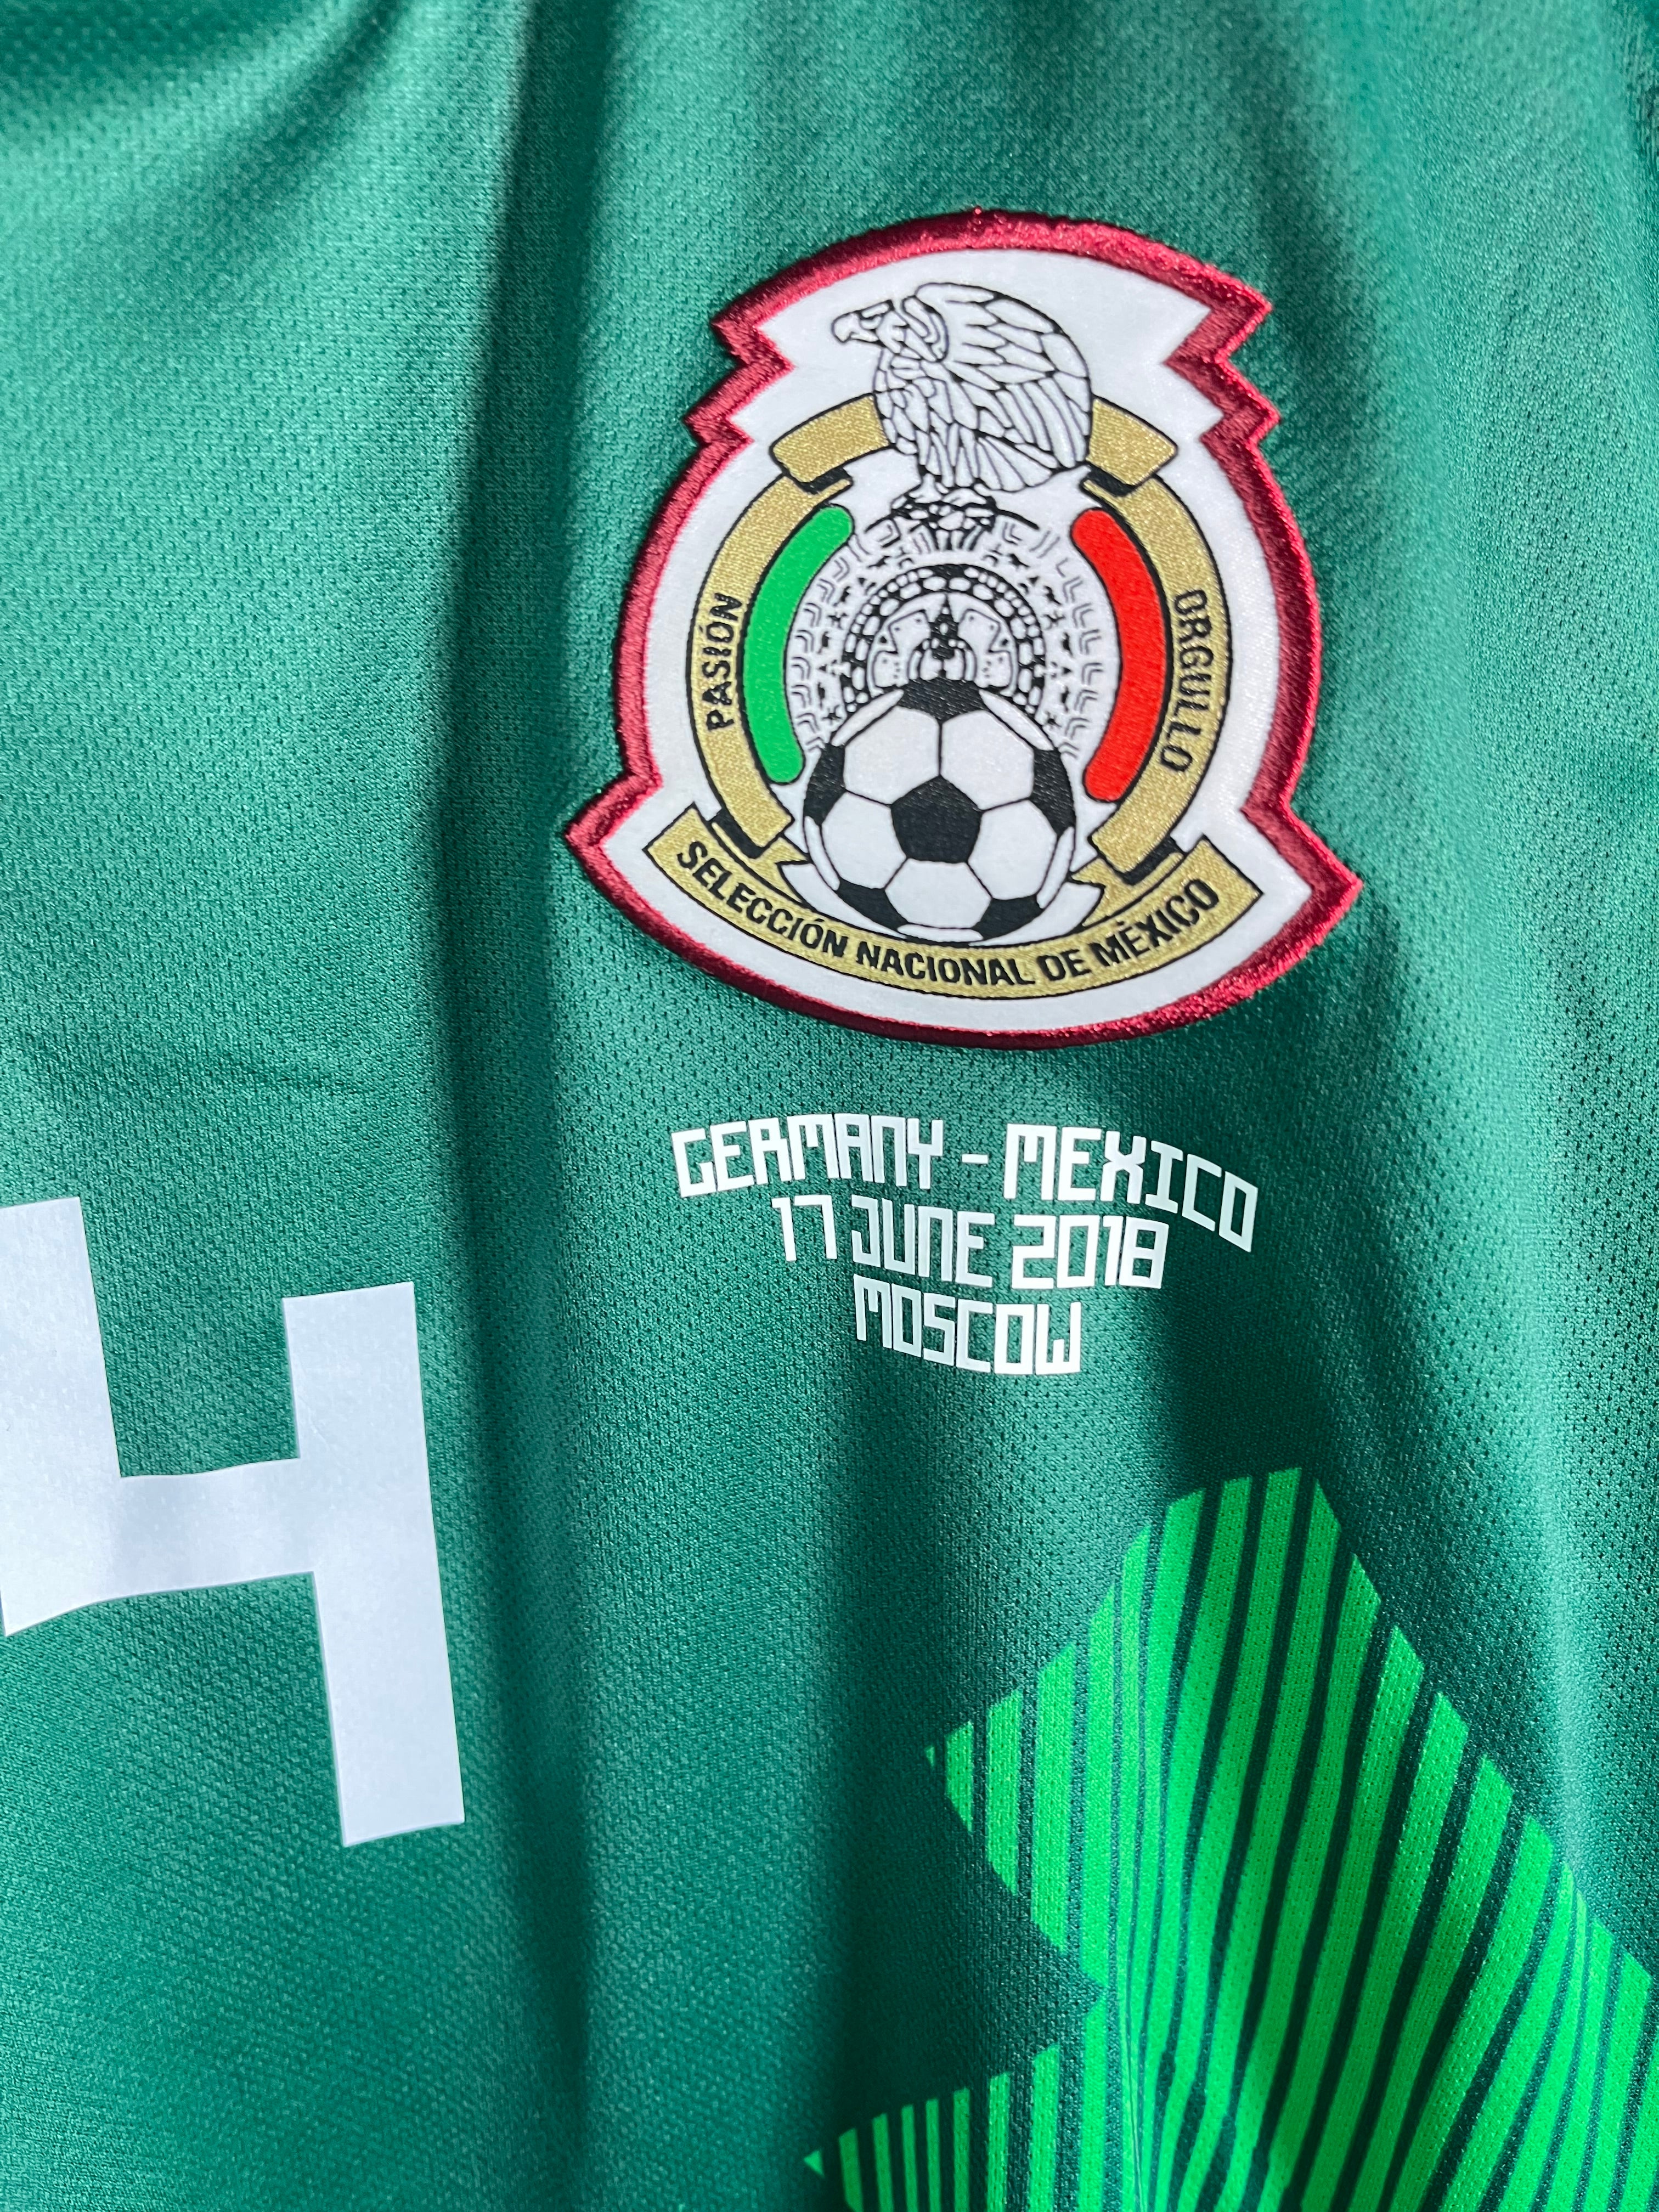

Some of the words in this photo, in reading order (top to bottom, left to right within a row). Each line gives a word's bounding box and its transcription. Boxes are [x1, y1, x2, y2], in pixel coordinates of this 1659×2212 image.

[698, 592, 744, 732] PASIÓN
[1160, 588, 1214, 772] ORGULLO
[676, 840, 848, 958] SELECCIÓN
[856, 940, 1035, 986] NACIONAL
[1036, 949, 1091, 981] DE
[1088, 878, 1220, 968] MÉXICO
[670, 1113, 944, 1199] GERMANY
[1002, 1123, 1259, 1253] MEXICO
[771, 1193, 838, 1262] 17
[851, 1194, 996, 1289] JUNE
[1011, 1213, 1170, 1291] 2018
[853, 1273, 1083, 1378] MOSCOW
